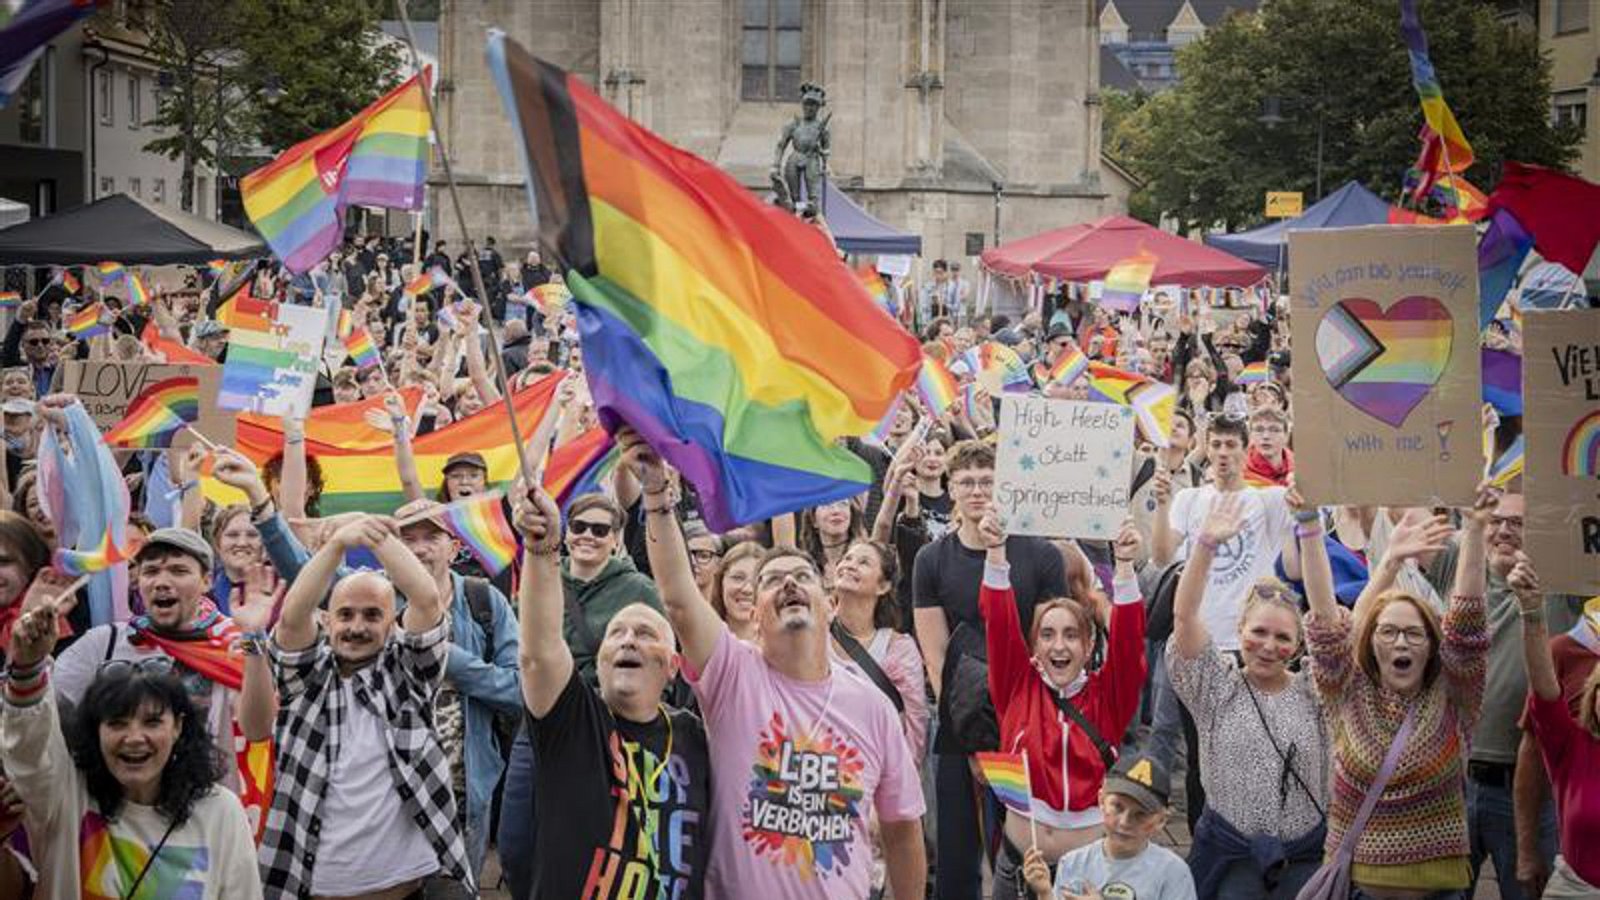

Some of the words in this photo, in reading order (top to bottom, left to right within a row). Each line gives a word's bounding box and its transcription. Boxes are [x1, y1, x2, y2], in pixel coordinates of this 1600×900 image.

[1334, 263, 1363, 288] can
[1368, 261, 1393, 281] be
[77, 362, 169, 399] LOVE
[1014, 400, 1062, 439] High
[1071, 406, 1120, 431] Heels
[1344, 433, 1384, 451] with
[1396, 435, 1425, 452] me
[609, 730, 691, 804] STOP
